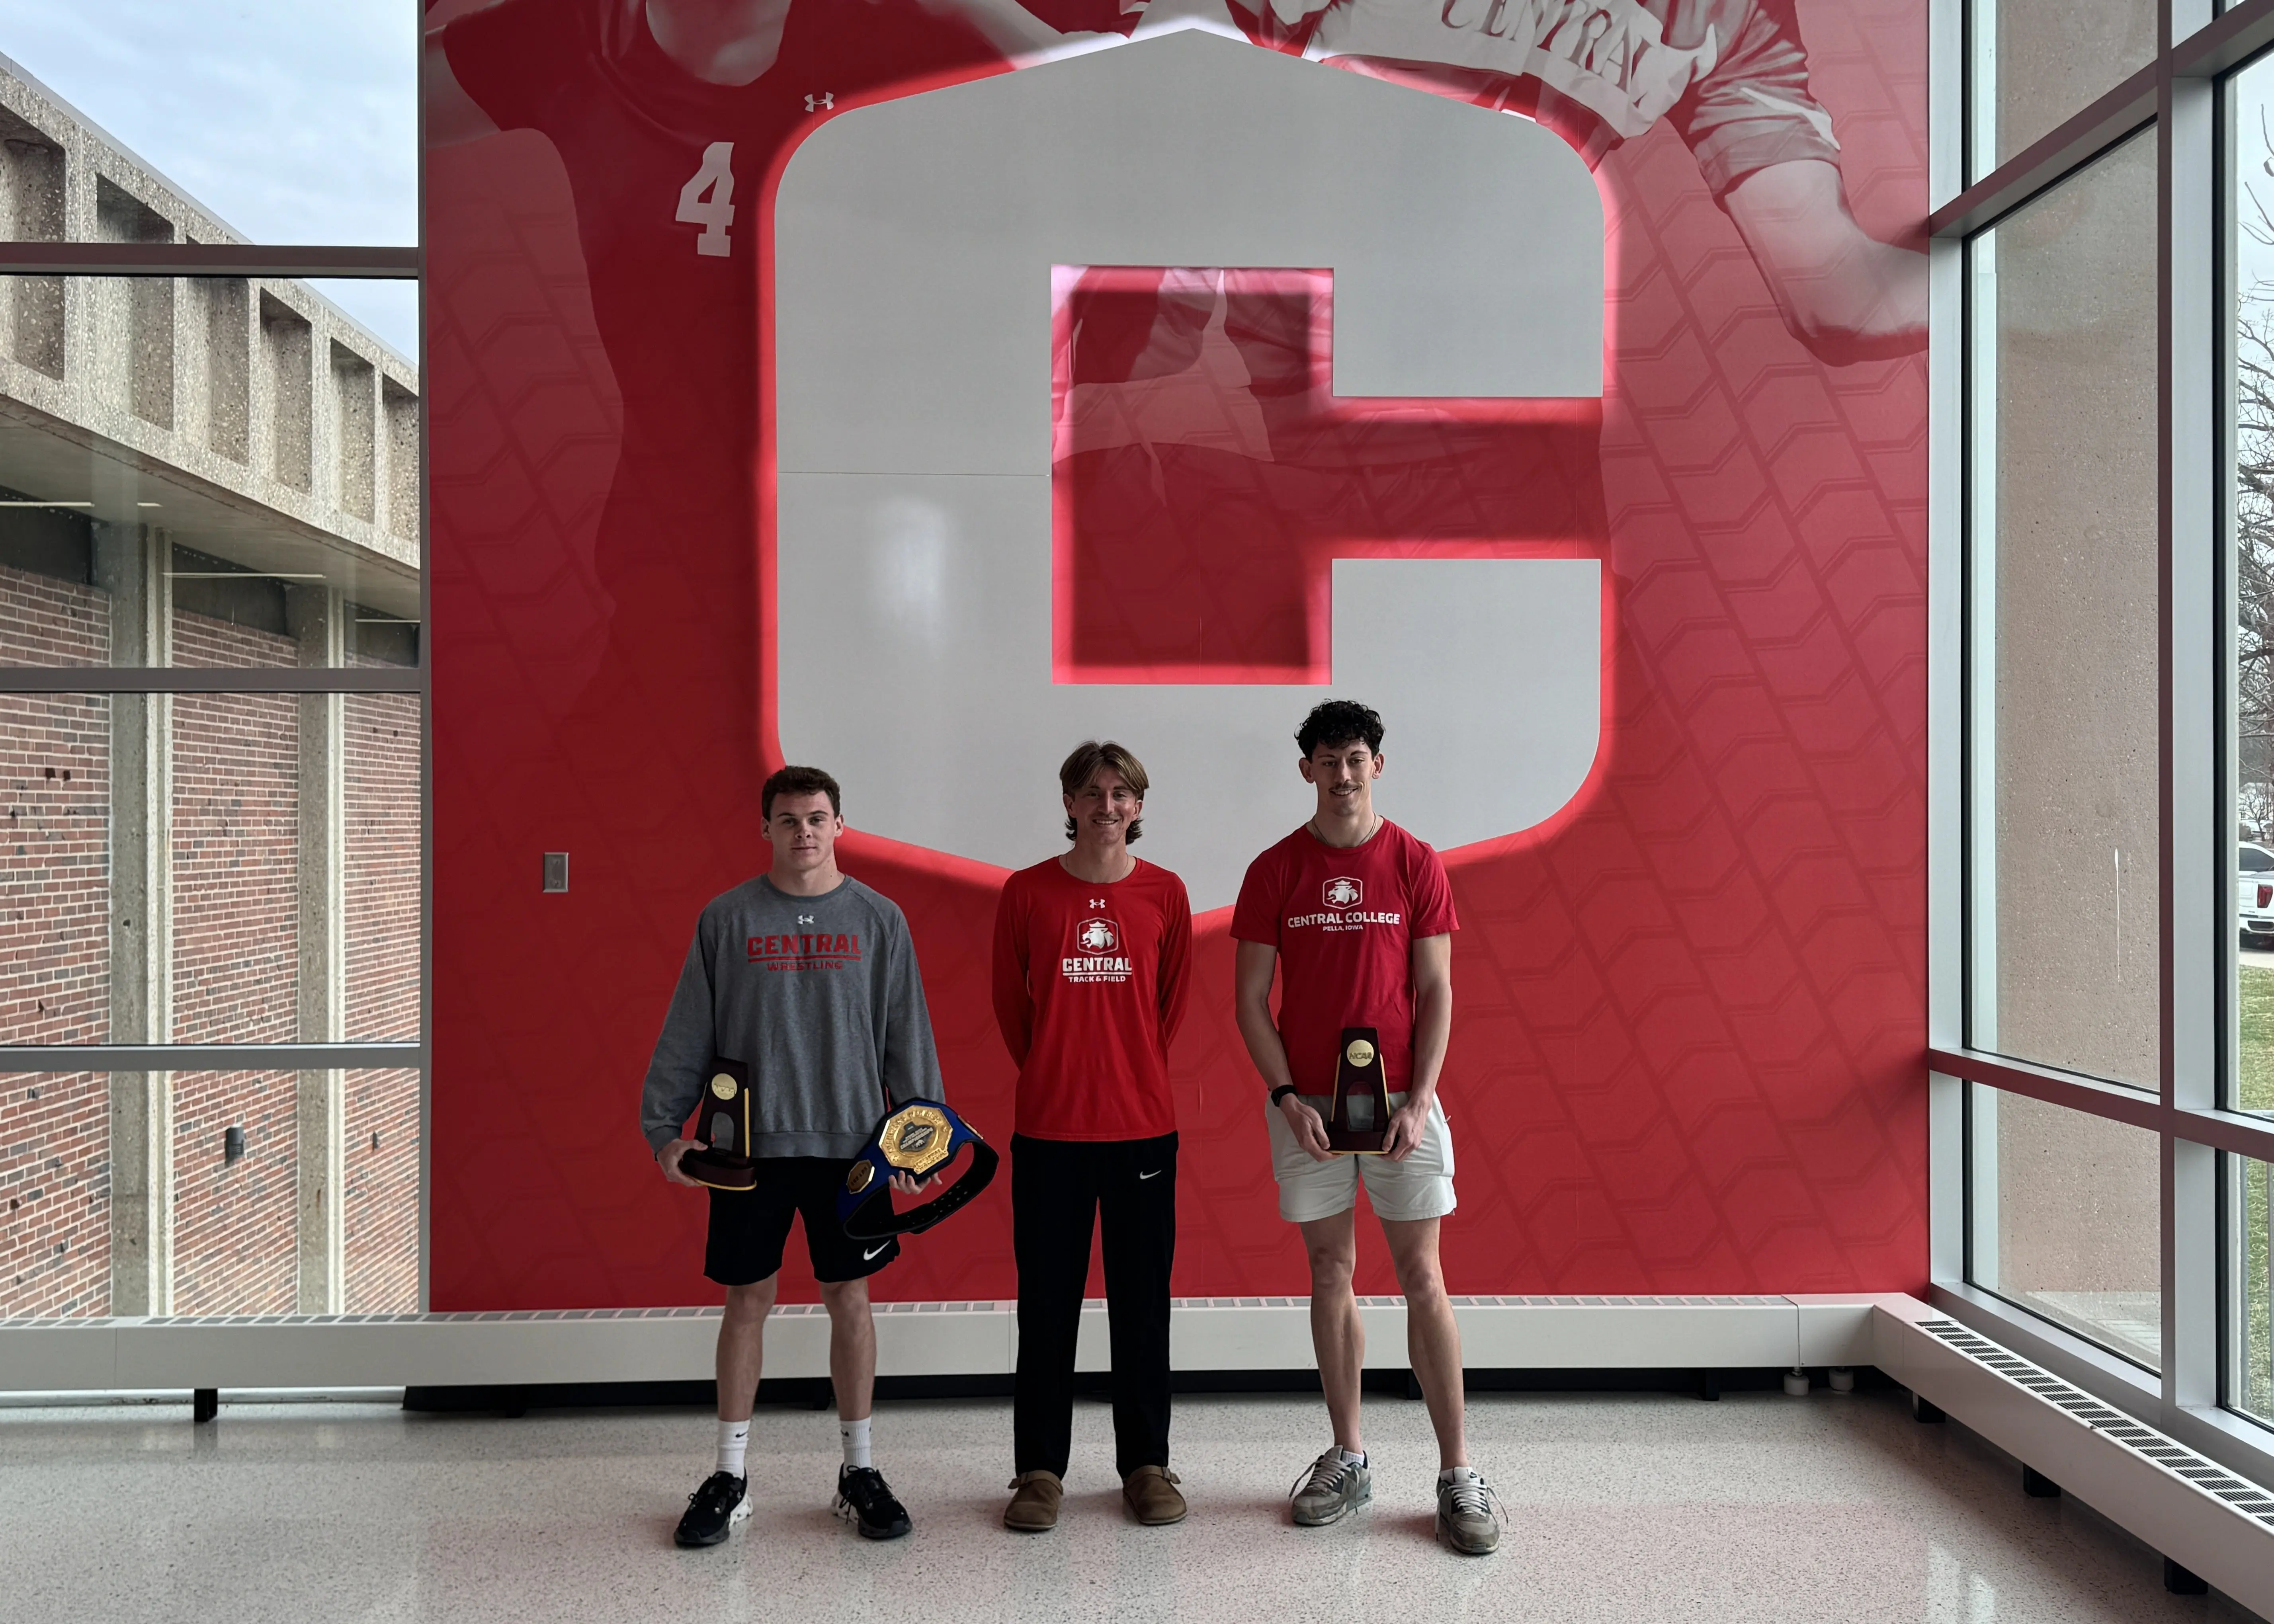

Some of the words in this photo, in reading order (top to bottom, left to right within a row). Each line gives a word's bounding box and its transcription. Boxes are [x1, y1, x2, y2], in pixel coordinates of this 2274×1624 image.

[675, 142, 735, 257] 4
[1287, 913, 1343, 928] CENTRAL
[1345, 912, 1401, 925] COLLEGE
[747, 934, 862, 956] CENTRAL
[767, 961, 842, 971] WRESTLING
[1063, 957, 1132, 971] CENTRAL
